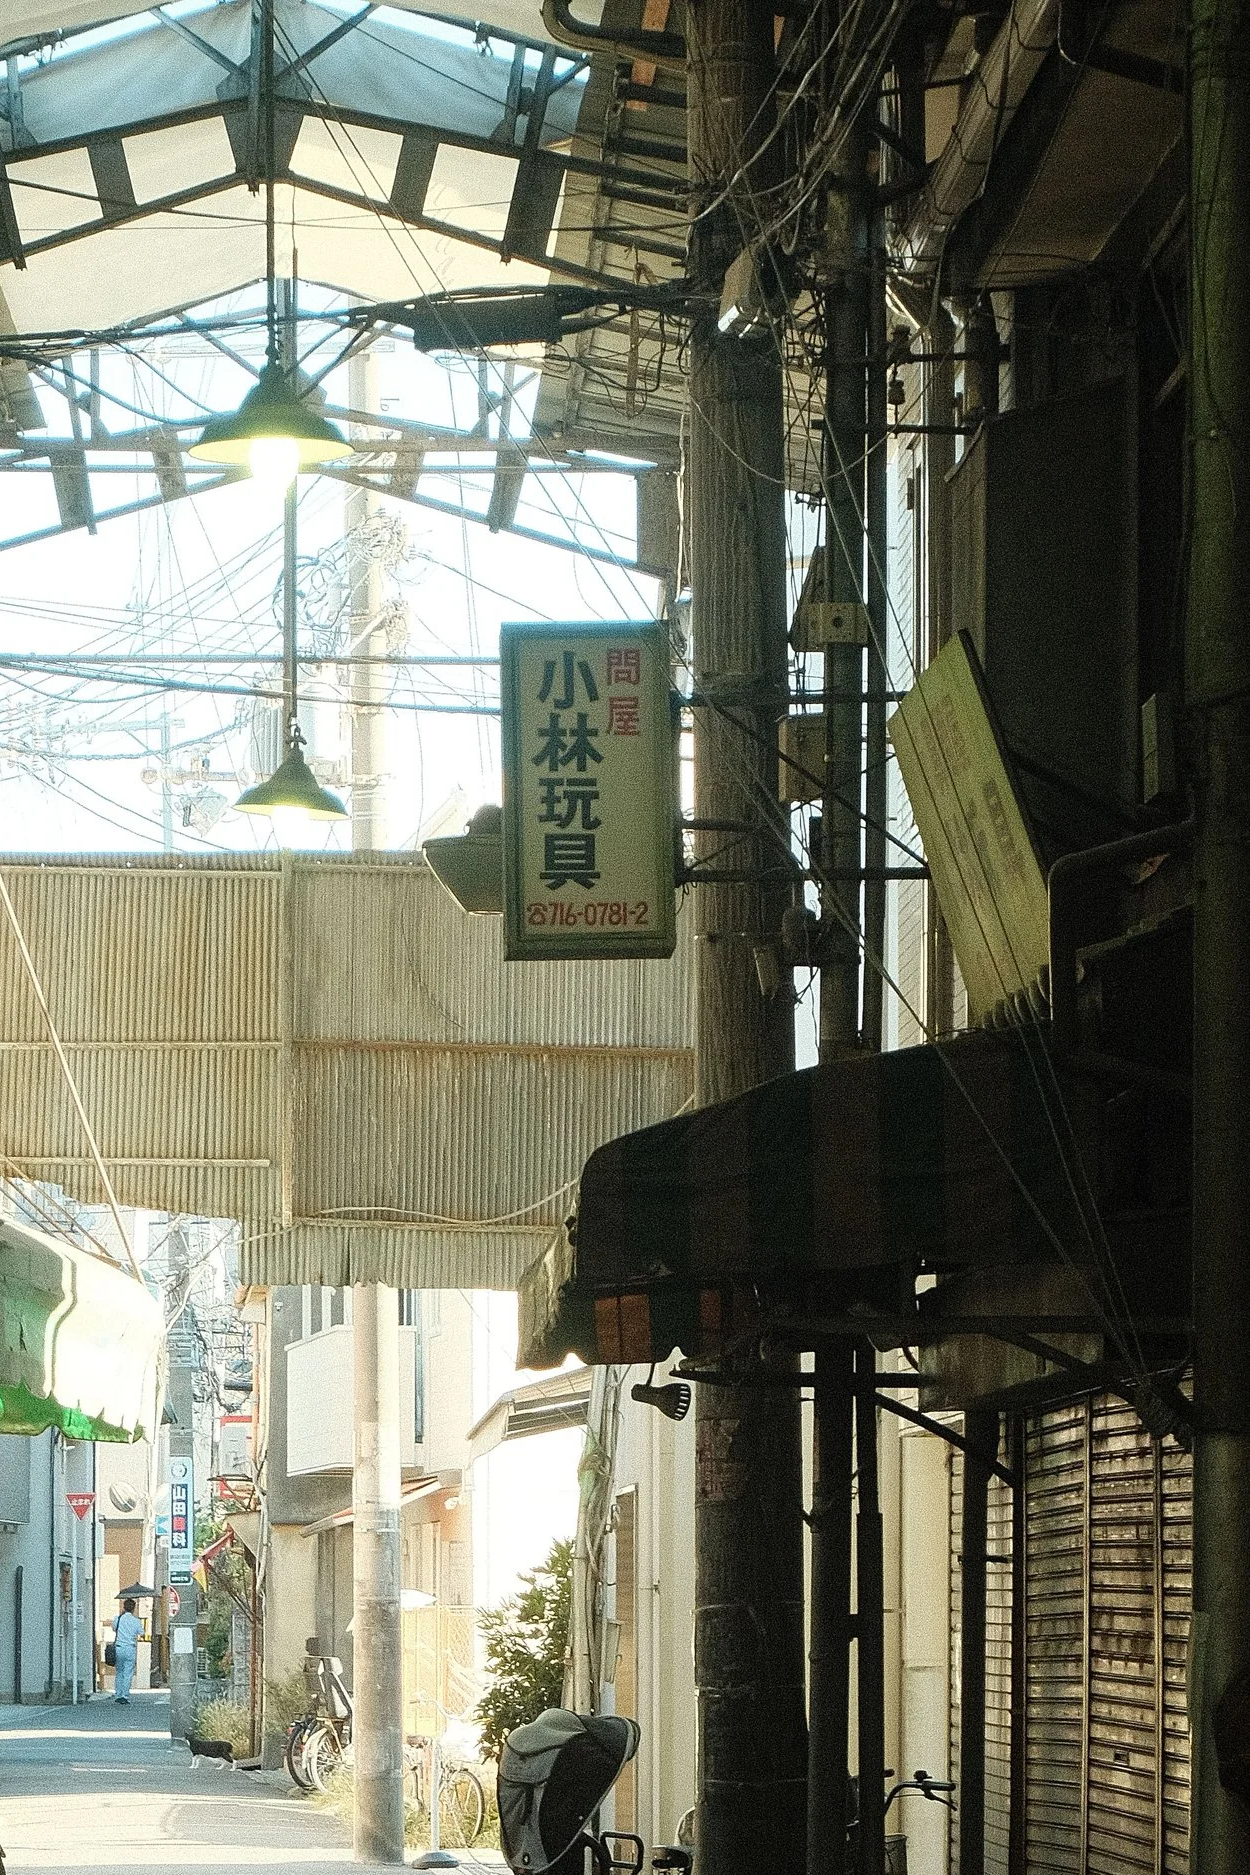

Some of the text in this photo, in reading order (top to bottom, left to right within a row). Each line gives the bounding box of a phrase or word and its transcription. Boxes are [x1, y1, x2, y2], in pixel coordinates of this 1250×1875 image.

[606, 648, 641, 737] 問屋
[531, 650, 604, 891] 小林玩具
[548, 901, 649, 926] 716-0781-2
